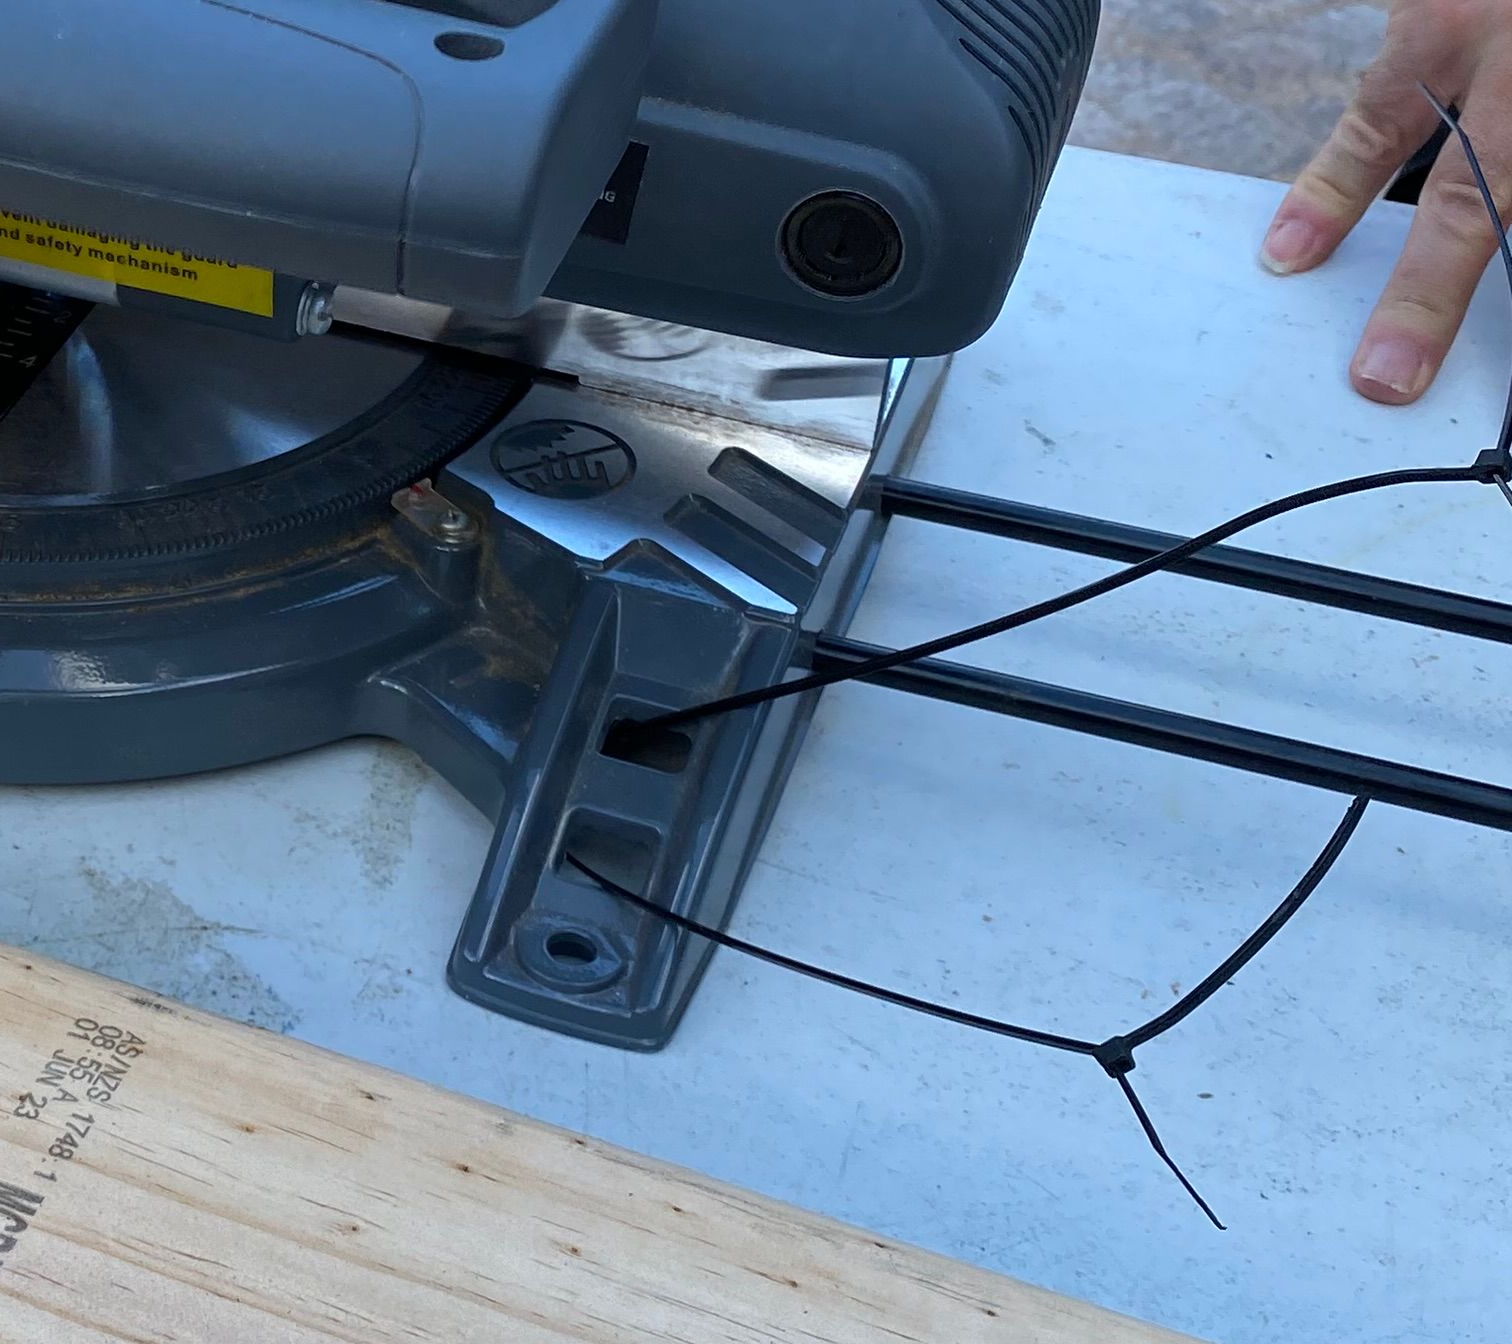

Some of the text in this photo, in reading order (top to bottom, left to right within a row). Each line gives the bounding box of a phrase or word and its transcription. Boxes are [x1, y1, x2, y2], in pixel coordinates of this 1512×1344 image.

[25, 232, 84, 257] safety
[88, 246, 199, 281] mechanism
[52, 310, 73, 326] 2
[17, 353, 39, 369] 4
[13, 1017, 99, 1121] 01 JUN 23
[52, 1024, 123, 1104] 08:55 A
[87, 1030, 146, 1104] AS/NZS
